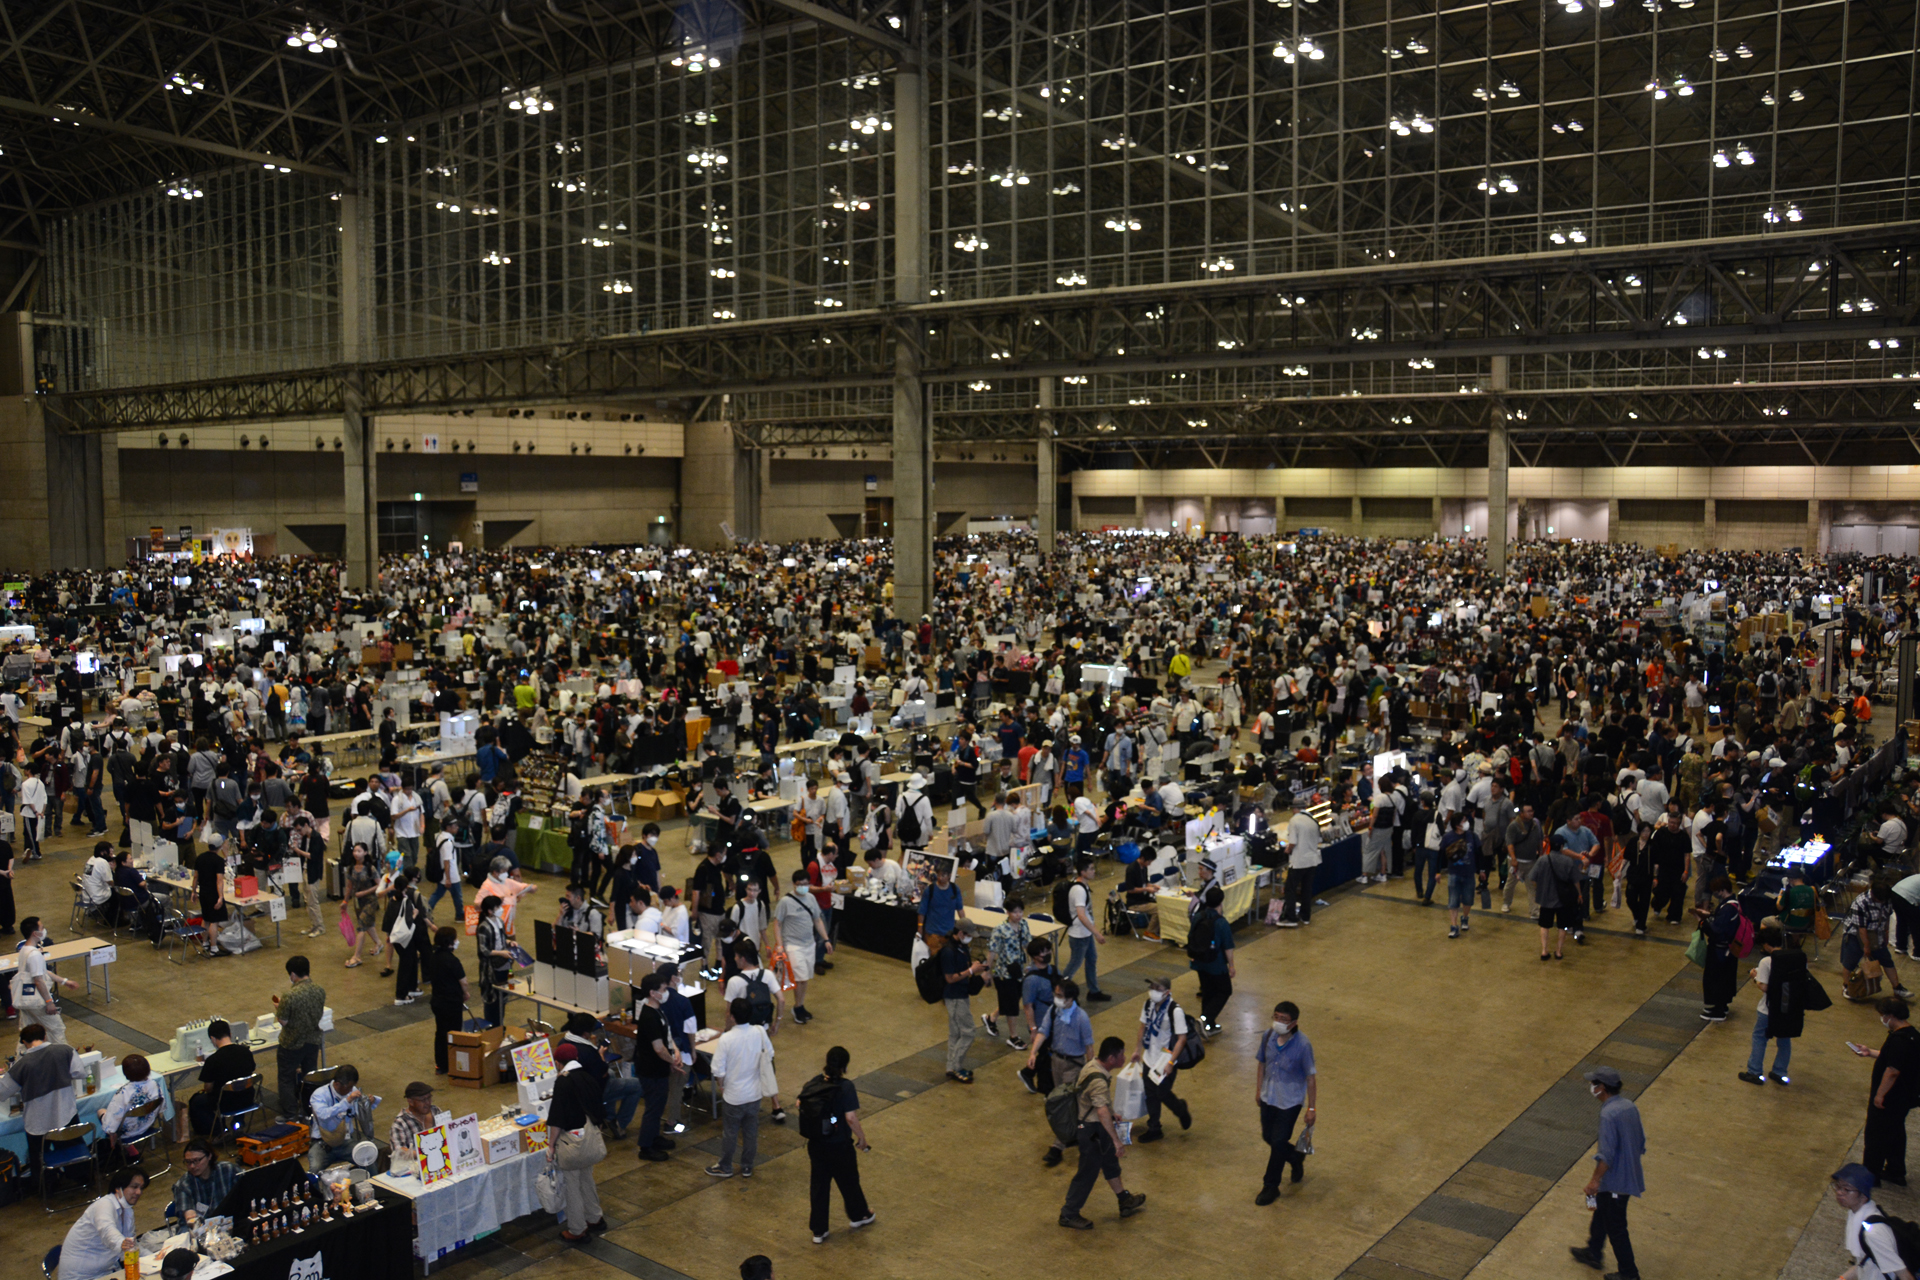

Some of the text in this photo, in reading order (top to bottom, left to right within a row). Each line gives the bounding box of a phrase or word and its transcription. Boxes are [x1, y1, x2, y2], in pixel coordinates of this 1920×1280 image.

[424, 1168, 453, 1182] ネコチャン
